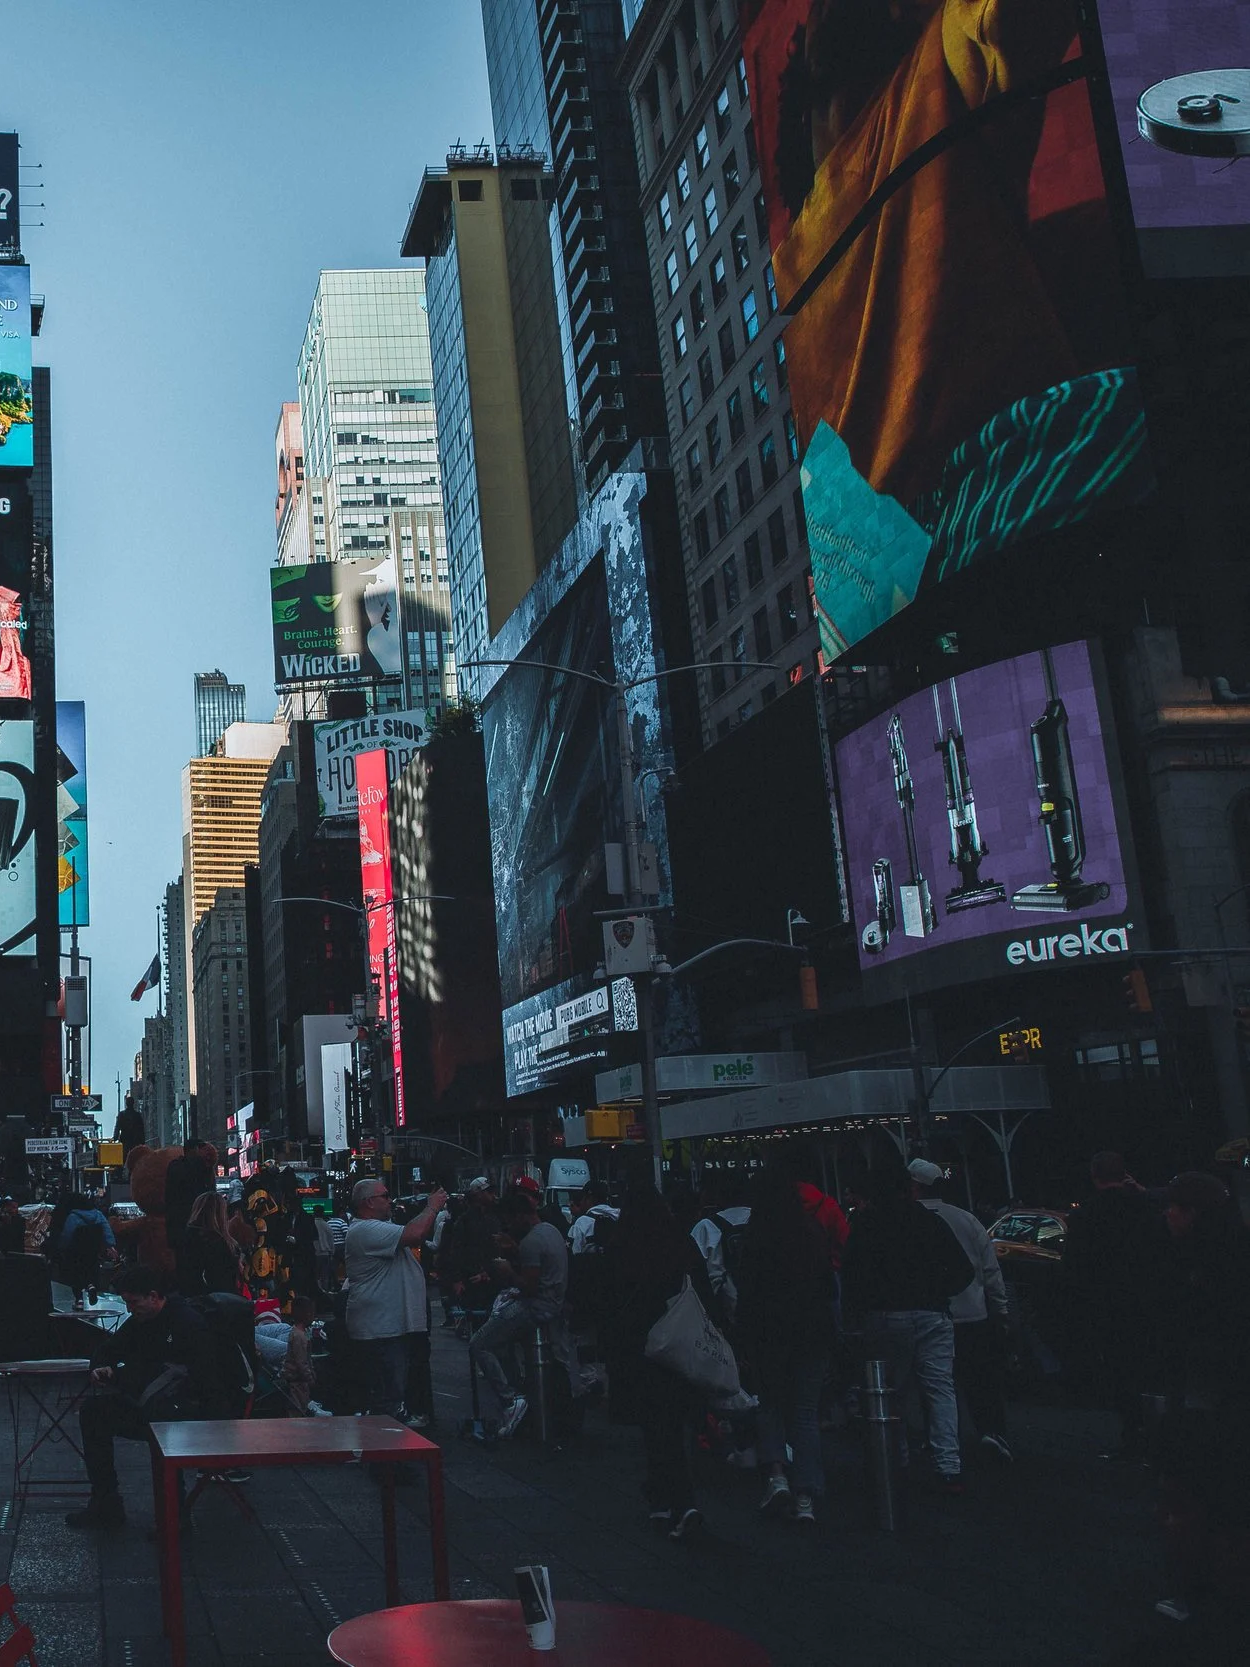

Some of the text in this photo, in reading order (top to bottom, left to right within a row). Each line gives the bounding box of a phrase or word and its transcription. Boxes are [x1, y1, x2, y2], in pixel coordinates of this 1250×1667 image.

[2, 331, 20, 339] VISA
[283, 625, 358, 640] Brains. Heart.
[297, 638, 345, 649] Courage.
[327, 719, 423, 754] LITTLE SHOP
[366, 741, 377, 749] OF
[1006, 923, 1128, 965] eureka
[560, 998, 592, 1023] PUBG MOBILE
[524, 1016, 535, 1038] THE
[712, 1055, 755, 1082] pelé
[59, 1100, 70, 1108] ON
[561, 1166, 587, 1181] Sysco
